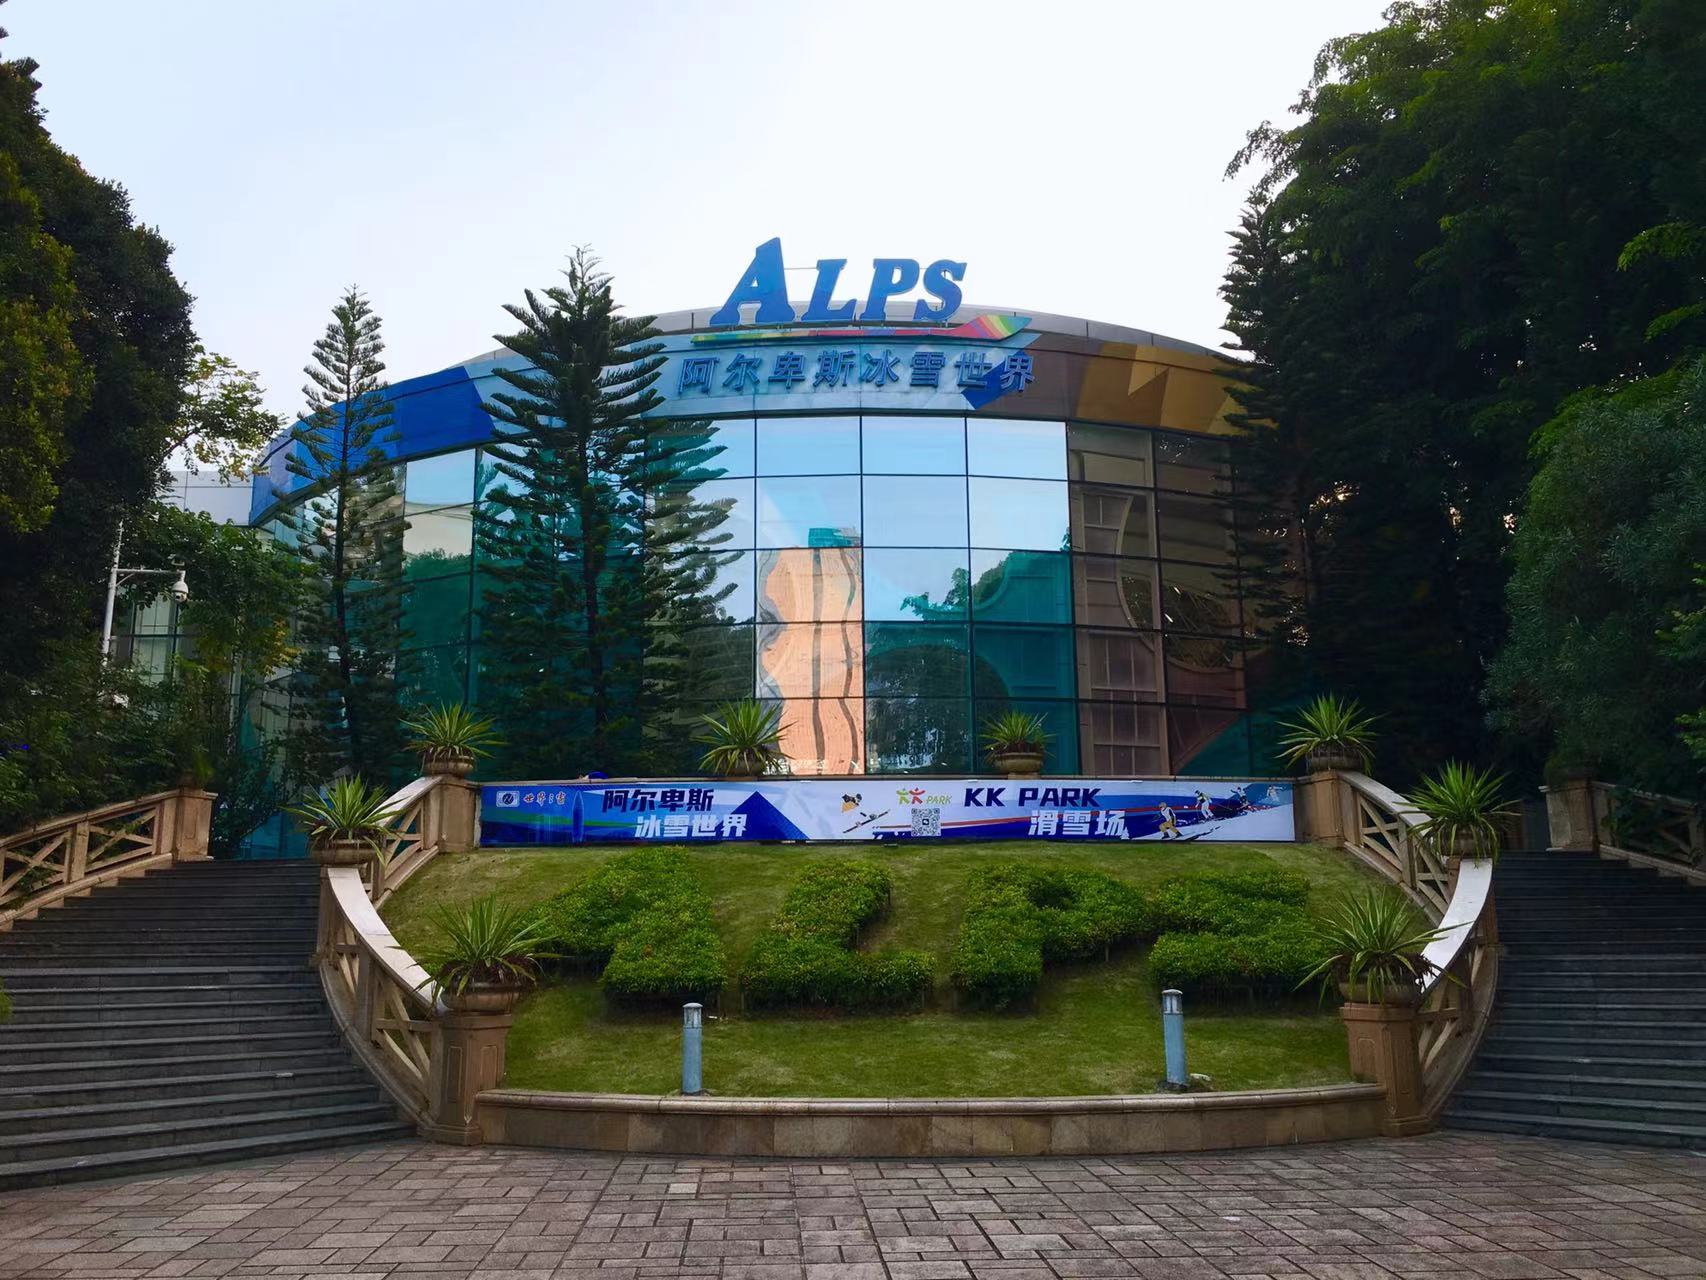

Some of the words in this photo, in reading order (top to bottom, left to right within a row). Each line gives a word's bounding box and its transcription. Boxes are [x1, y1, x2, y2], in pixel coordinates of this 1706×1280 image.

[709, 236, 968, 326] ALPS
[677, 349, 1035, 394] 阿尔卑斯冰雪世界
[603, 788, 714, 812] 阿尔卑斯
[964, 787, 1007, 807] KK
[1018, 787, 1102, 808] PARK
[635, 814, 748, 838] 冰雪世界
[1028, 809, 1130, 840] 滑雪场
